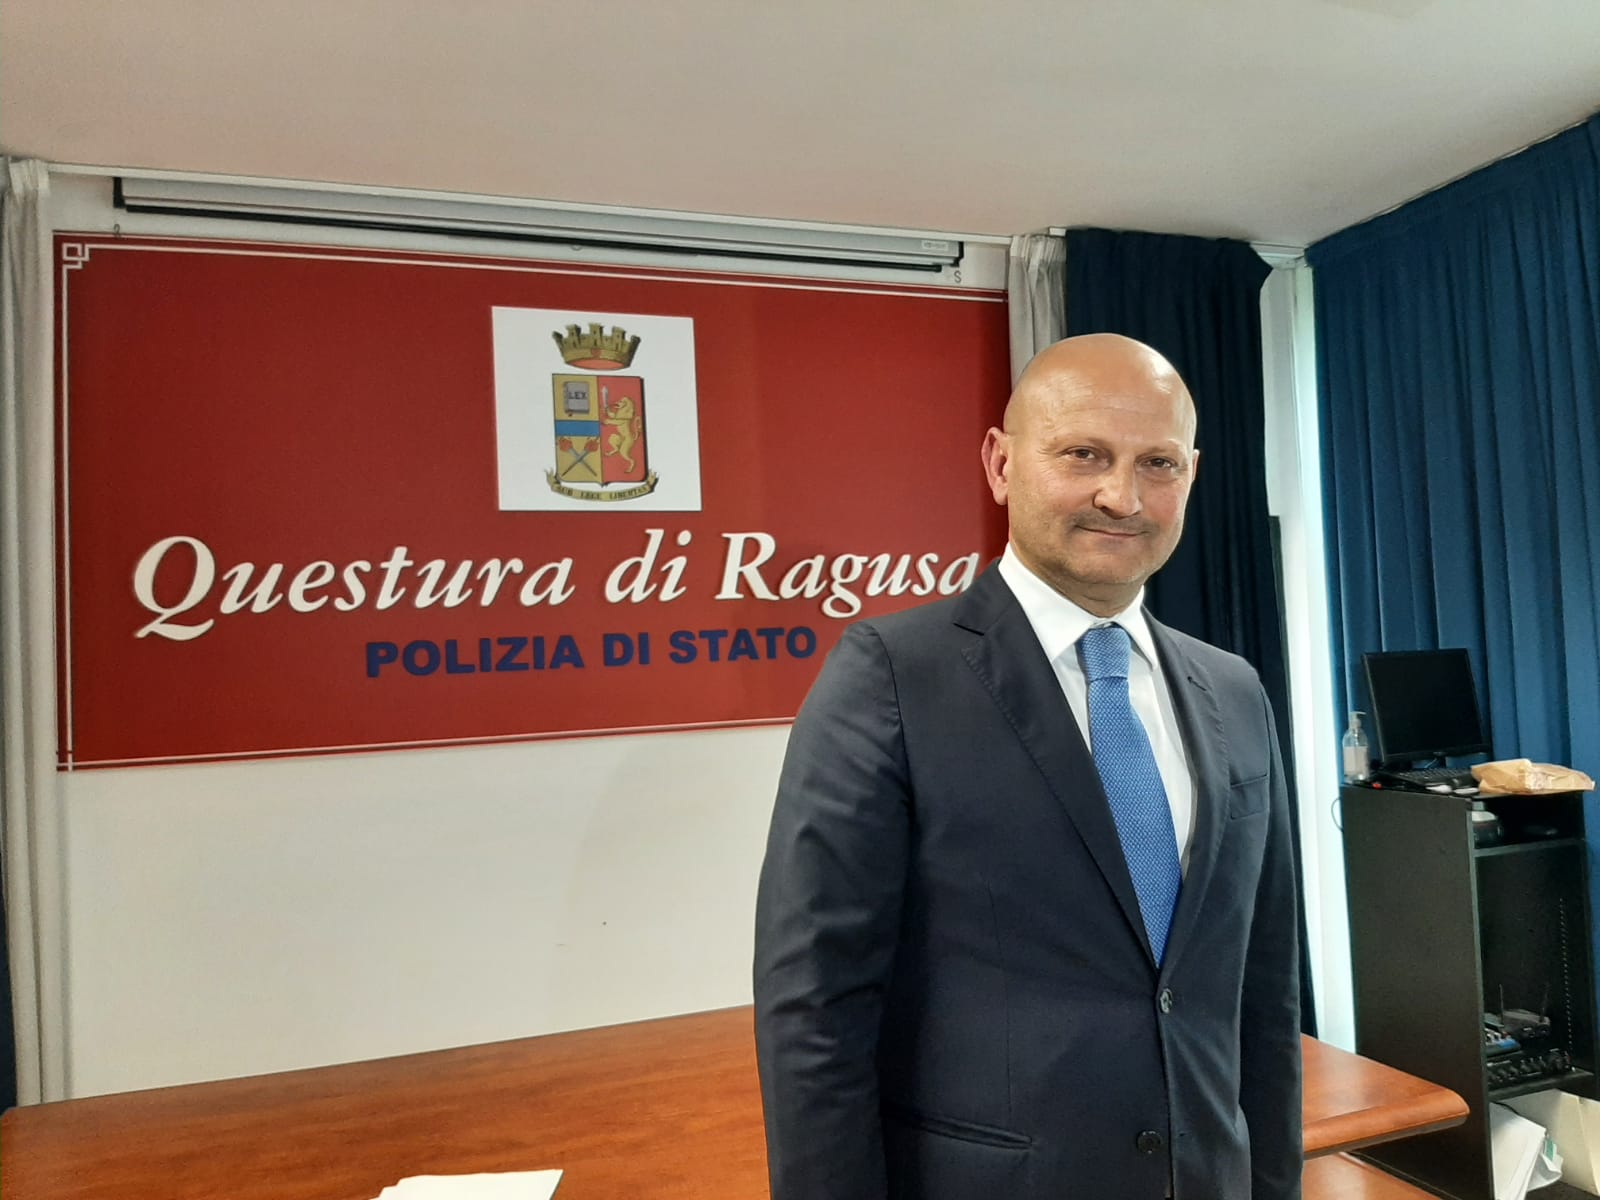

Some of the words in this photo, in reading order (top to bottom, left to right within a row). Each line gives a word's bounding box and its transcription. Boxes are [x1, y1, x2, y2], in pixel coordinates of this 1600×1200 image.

[568, 391, 588, 400] LEX
[133, 535, 576, 640] Questura
[604, 528, 692, 603] di
[715, 532, 980, 618] Ragusa
[366, 635, 585, 678] POLIZIA
[603, 632, 650, 667] DI
[669, 627, 817, 664] STATO
